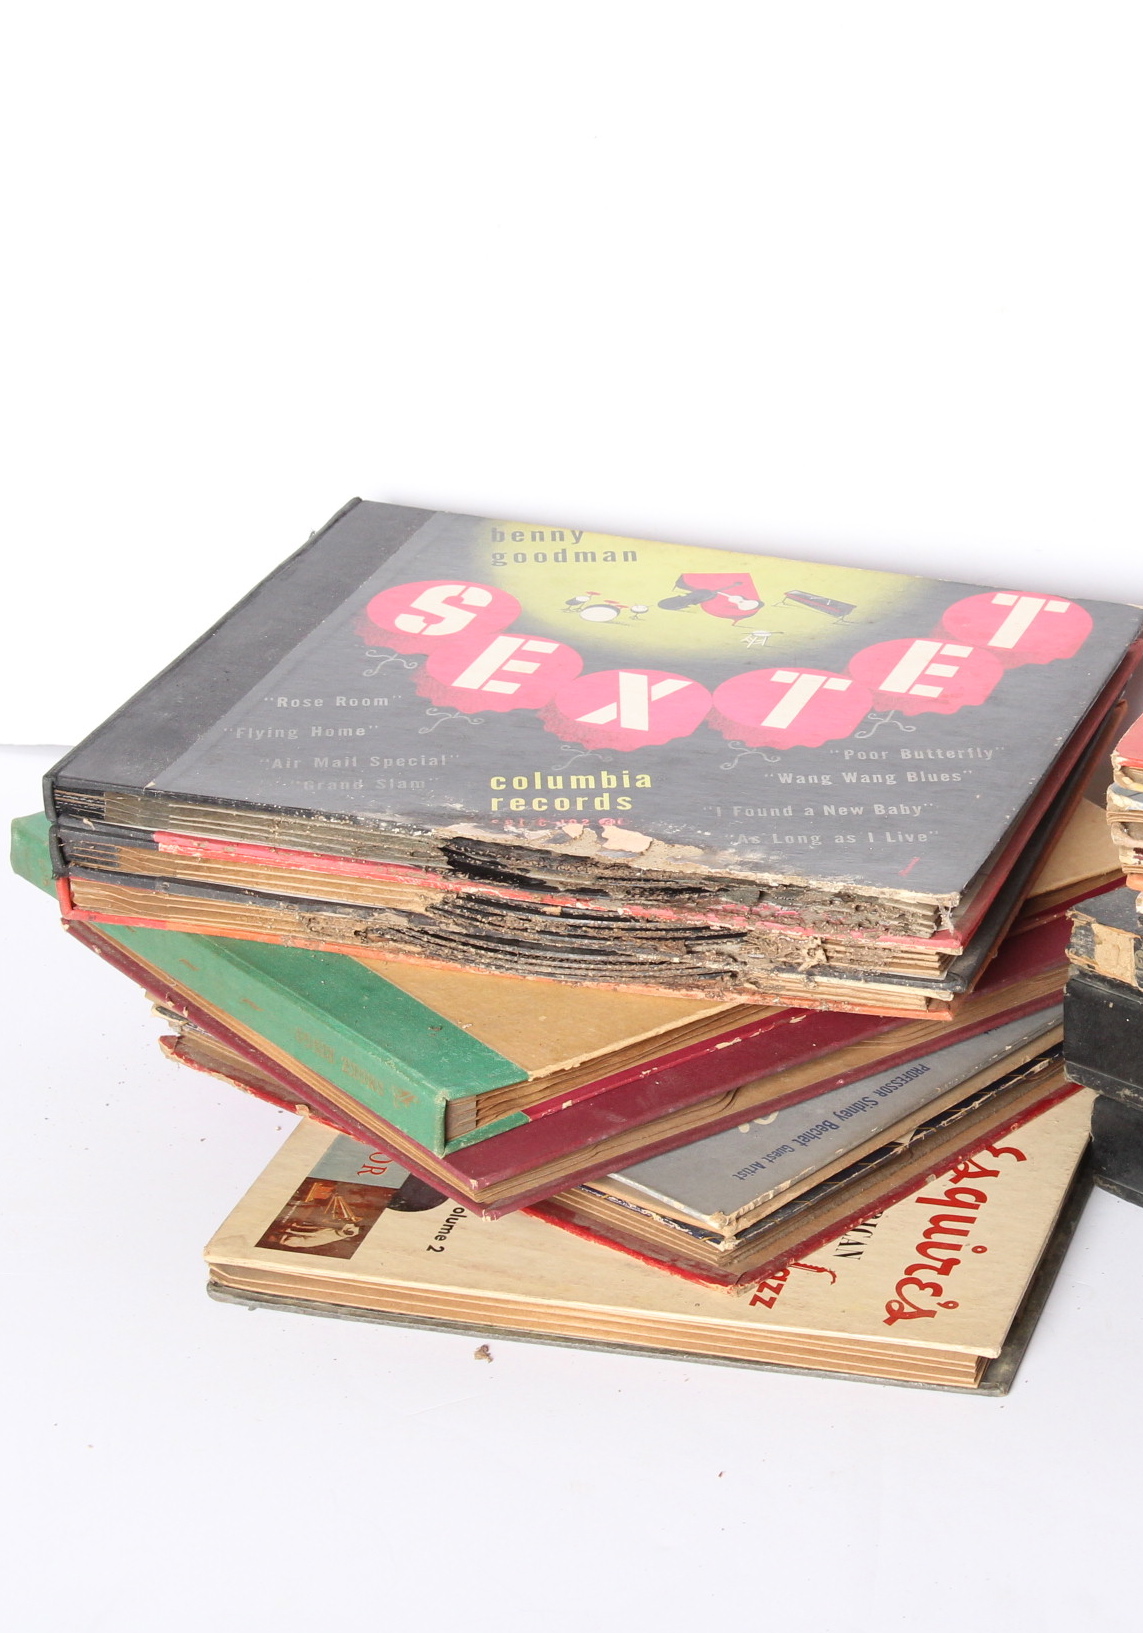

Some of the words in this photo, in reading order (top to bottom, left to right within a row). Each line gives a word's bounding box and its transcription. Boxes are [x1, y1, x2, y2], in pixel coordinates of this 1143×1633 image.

[491, 527, 585, 545] benny
[491, 548, 639, 567] goodman
[394, 584, 1071, 732] SEXTET
[314, 755, 358, 768] Mail
[490, 771, 652, 791] columbia
[841, 770, 895, 785] Wang
[490, 793, 633, 811] records
[734, 804, 793, 817] Found
[804, 806, 814, 816] a
[824, 803, 863, 816] New
[772, 832, 828, 849] Long
[835, 833, 857, 844] as
[872, 1063, 930, 1097] PROFESSOR
[832, 1096, 880, 1121] Sidney
[790, 1119, 840, 1147] Bechet
[765, 1143, 796, 1163] Guest
[356, 1151, 394, 1177] OR
[732, 1159, 766, 1181] Artist
[434, 1206, 468, 1242] olume
[883, 1145, 1028, 1326] Esquire's
[426, 1244, 446, 1254] 2
